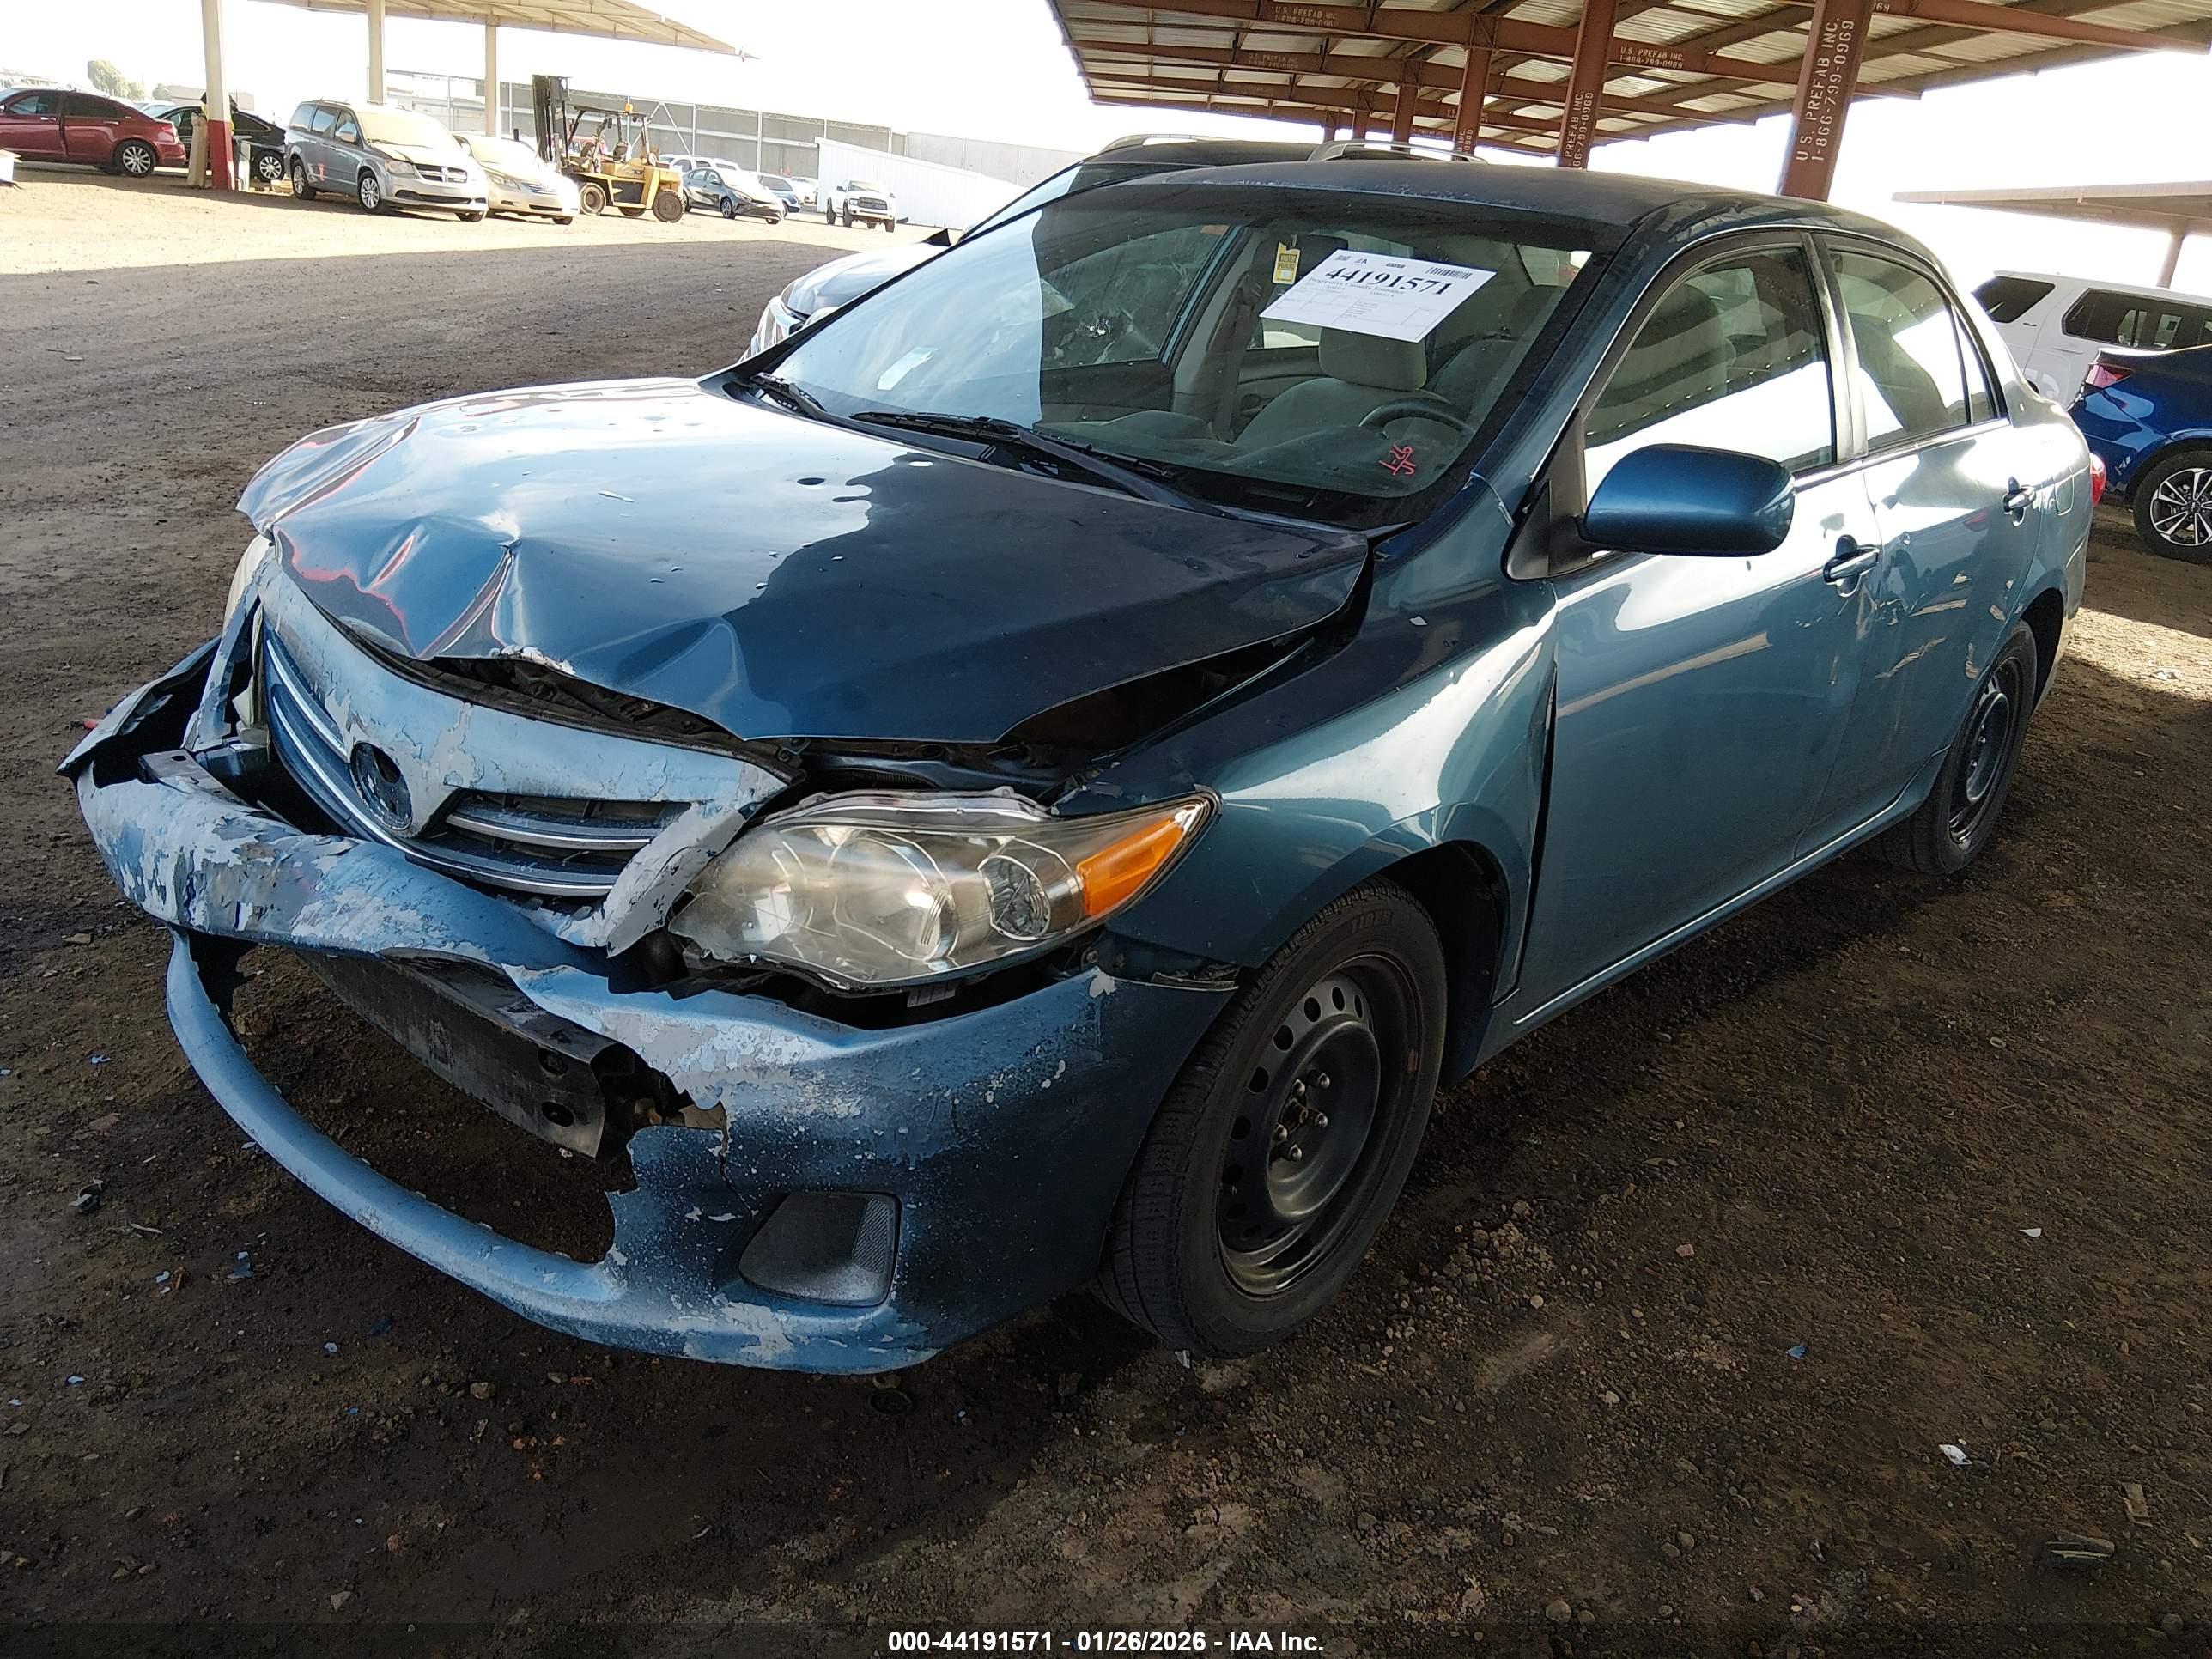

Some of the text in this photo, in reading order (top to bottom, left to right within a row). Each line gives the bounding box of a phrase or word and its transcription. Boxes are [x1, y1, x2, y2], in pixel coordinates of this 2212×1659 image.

[1638, 48, 1668, 60] PREFAB
[1805, 57, 1830, 121] PREFAB
[1821, 17, 1840, 49] INC.
[1811, 20, 1855, 161] 1-866-799-0969
[1564, 116, 1579, 158] PREFAB
[1325, 267, 1453, 295] 44191571
